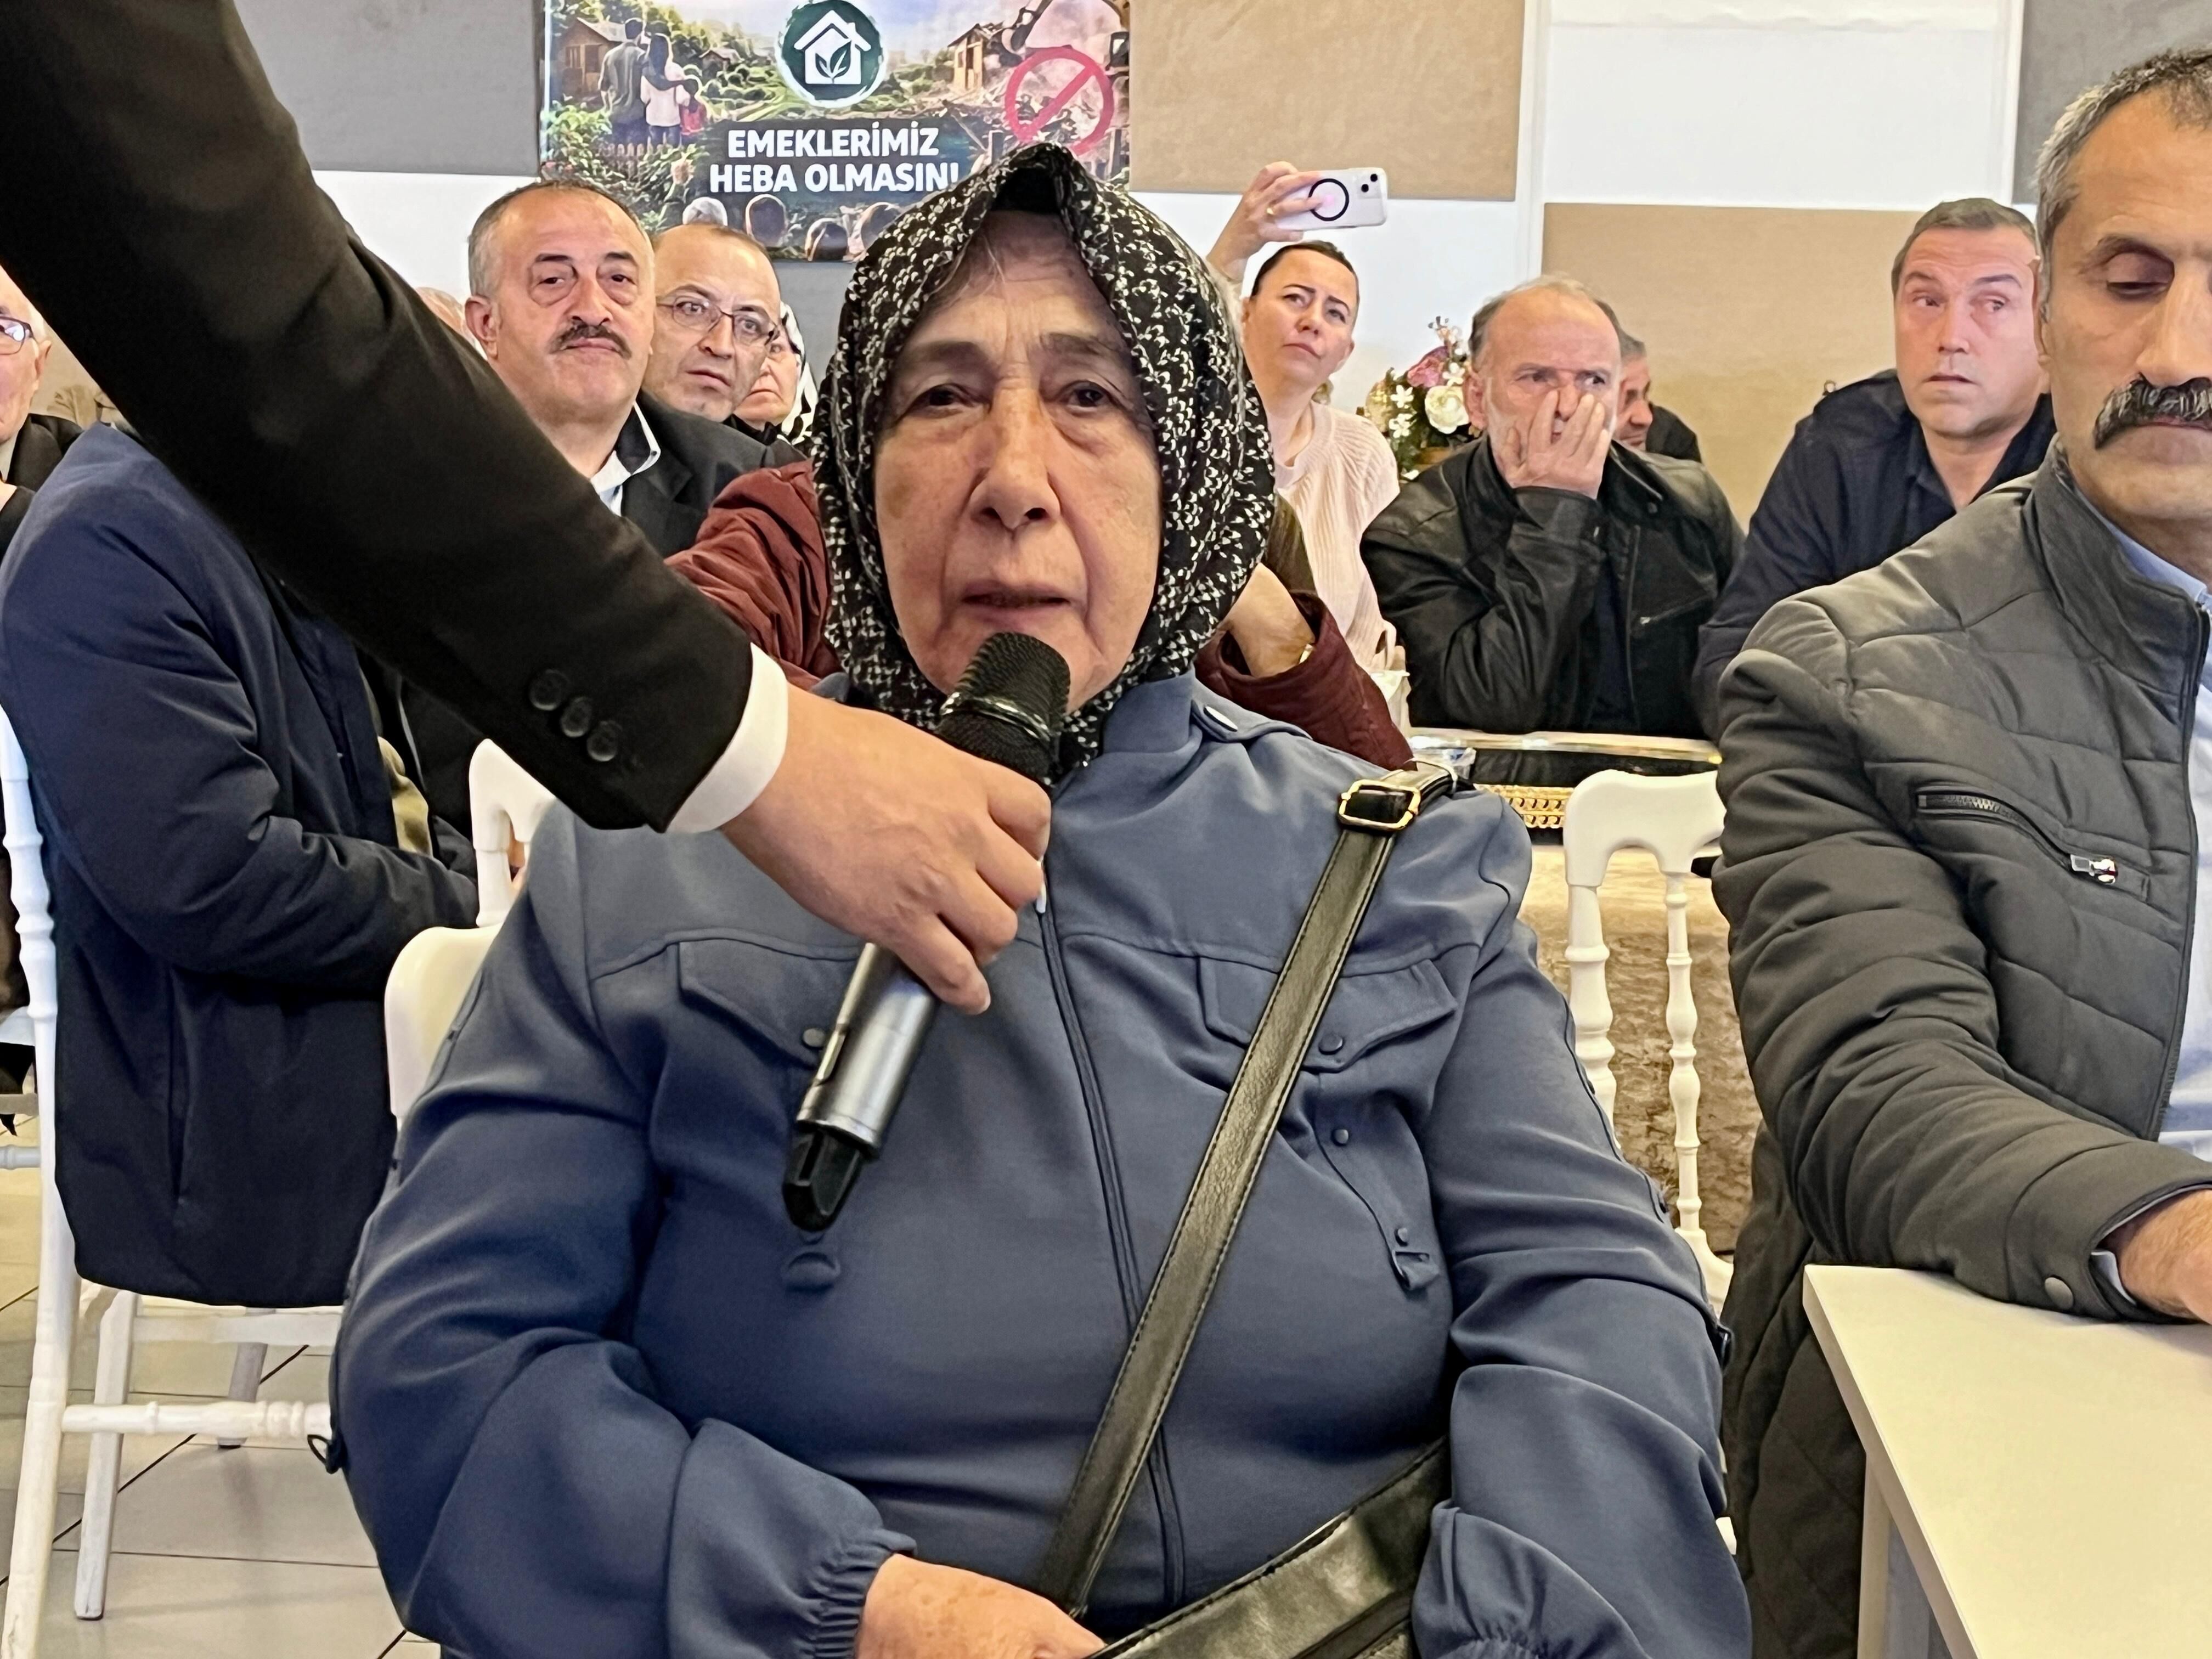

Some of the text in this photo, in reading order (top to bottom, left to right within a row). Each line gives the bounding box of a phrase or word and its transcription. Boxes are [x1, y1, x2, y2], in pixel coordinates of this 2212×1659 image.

[728, 121, 939, 158] EMEKLERİMİZ
[709, 162, 959, 193] HEBA OLMASIN!
